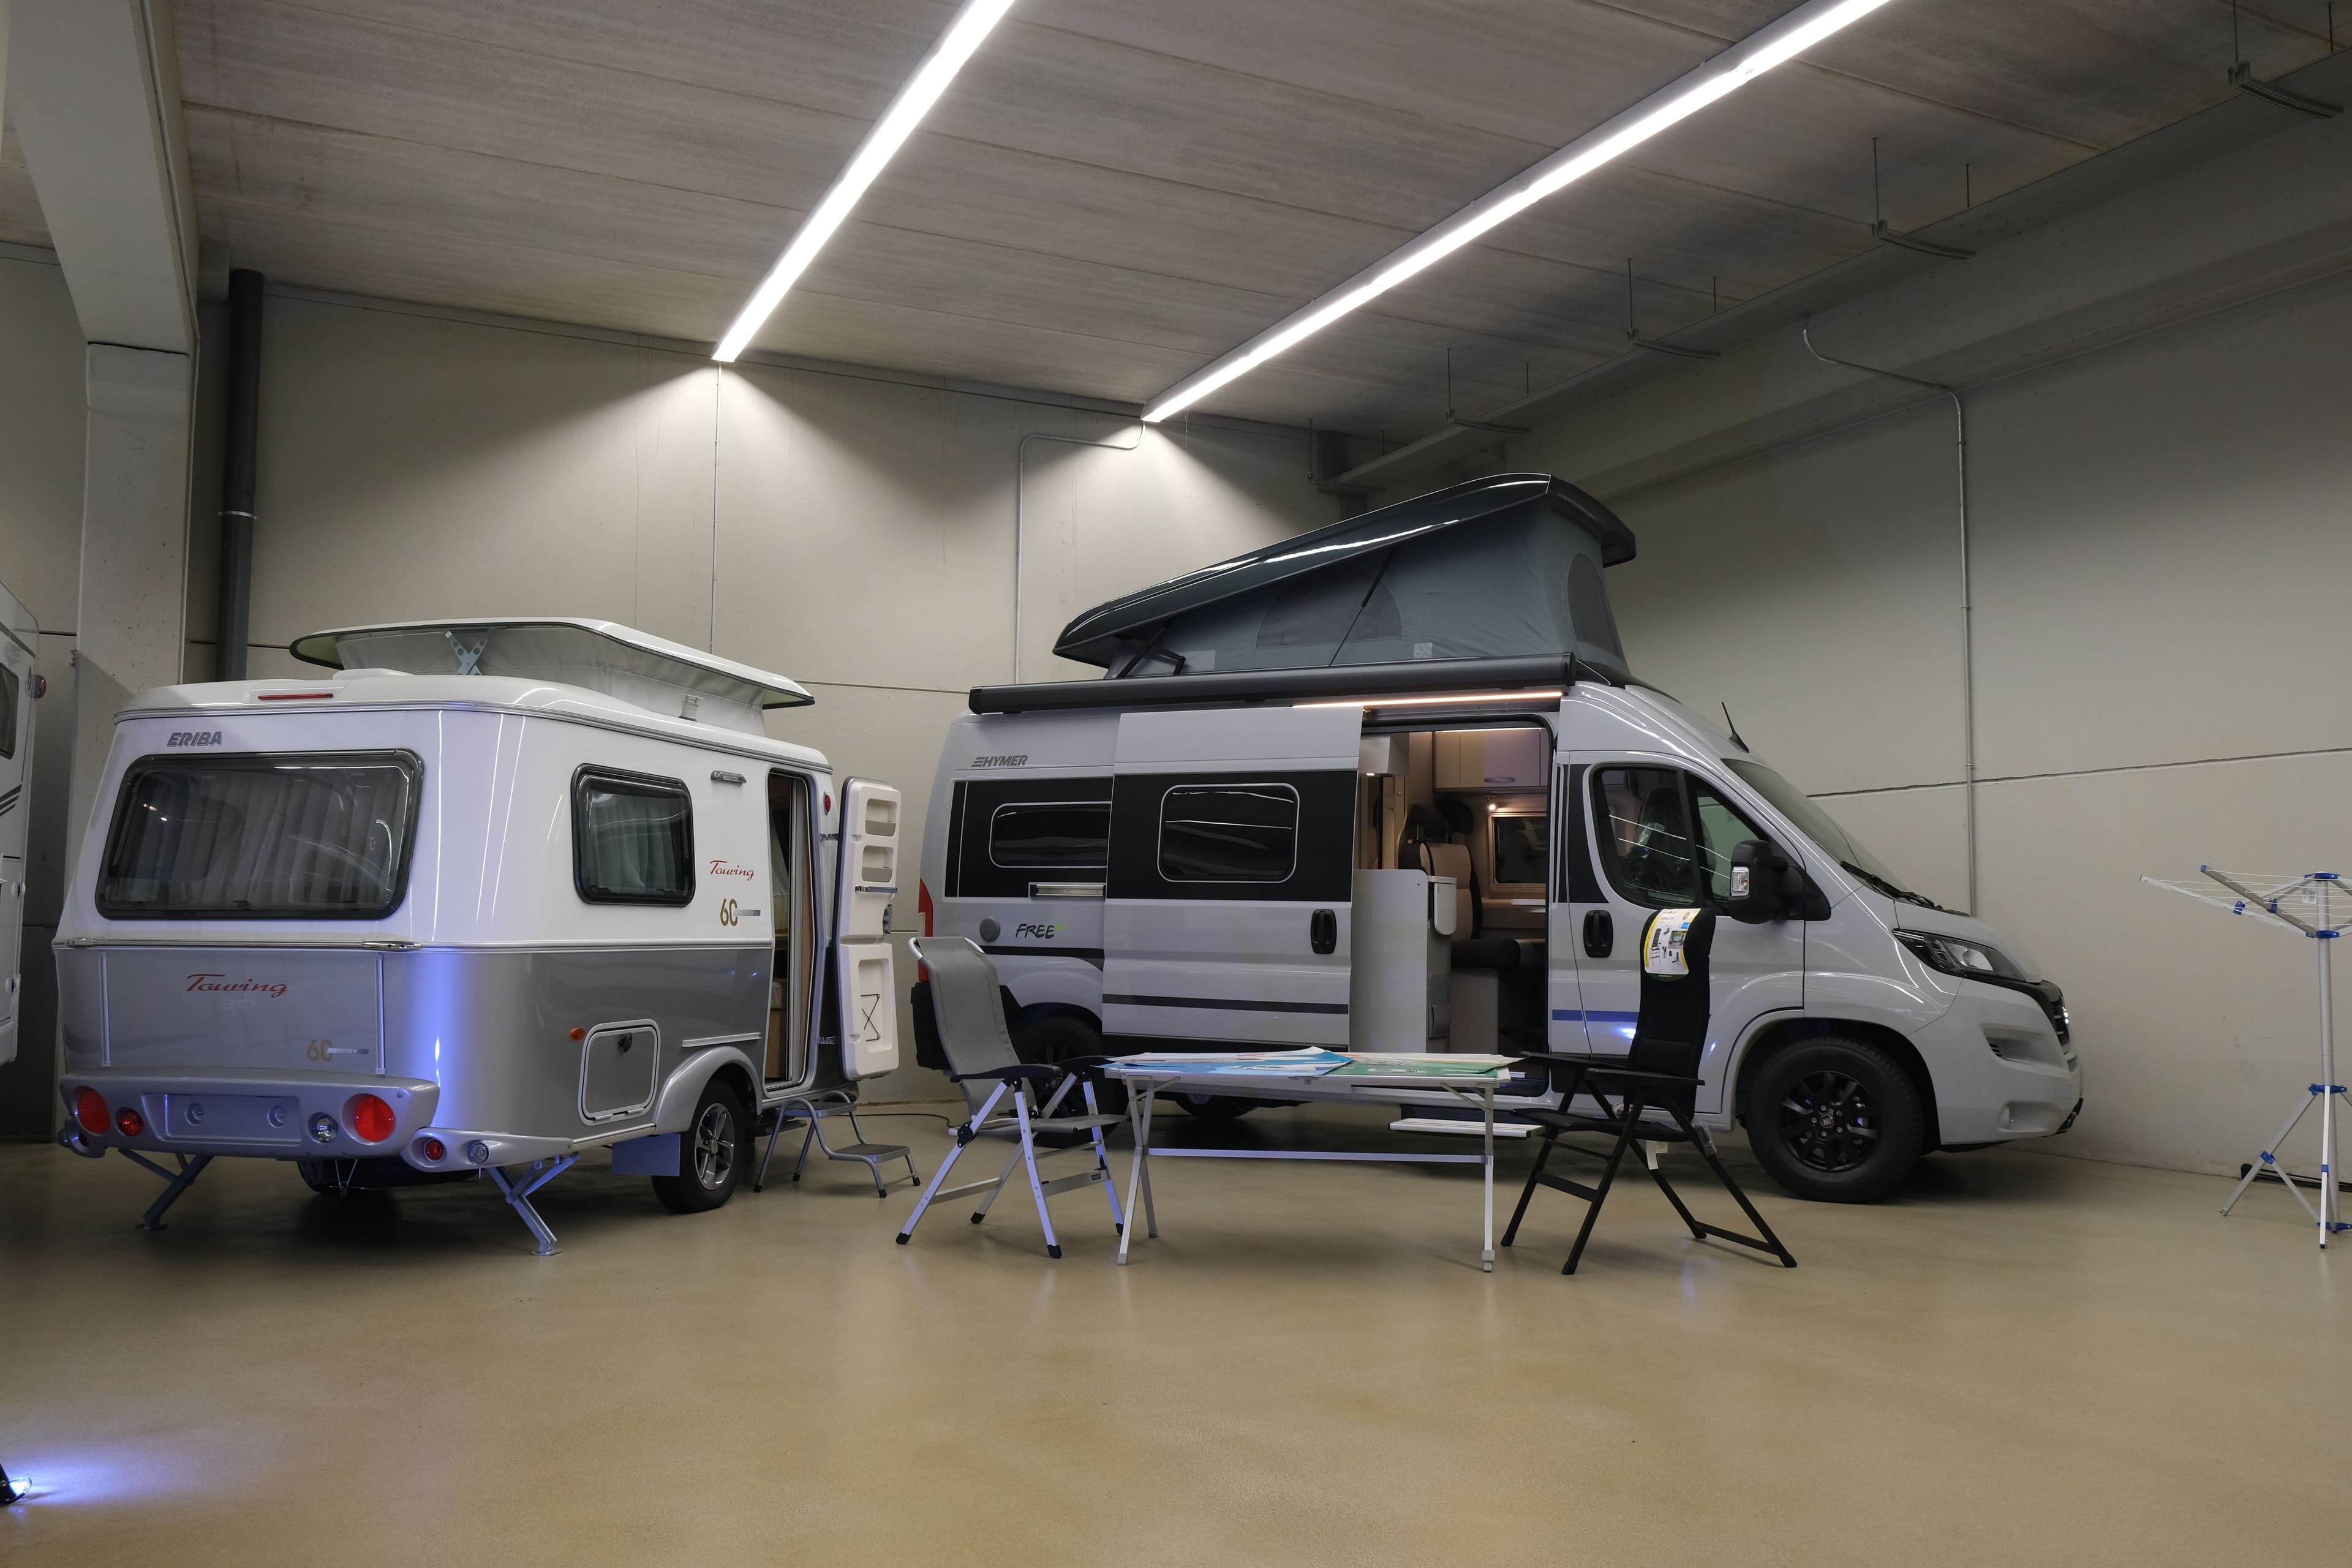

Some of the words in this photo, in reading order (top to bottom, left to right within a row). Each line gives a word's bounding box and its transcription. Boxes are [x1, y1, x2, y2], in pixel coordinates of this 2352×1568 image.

[167, 731, 222, 747] ERIBA
[982, 755, 1028, 767] HYMER
[710, 860, 755, 881] Touring
[1016, 924, 1055, 939] FREE
[186, 974, 289, 998] Touring
